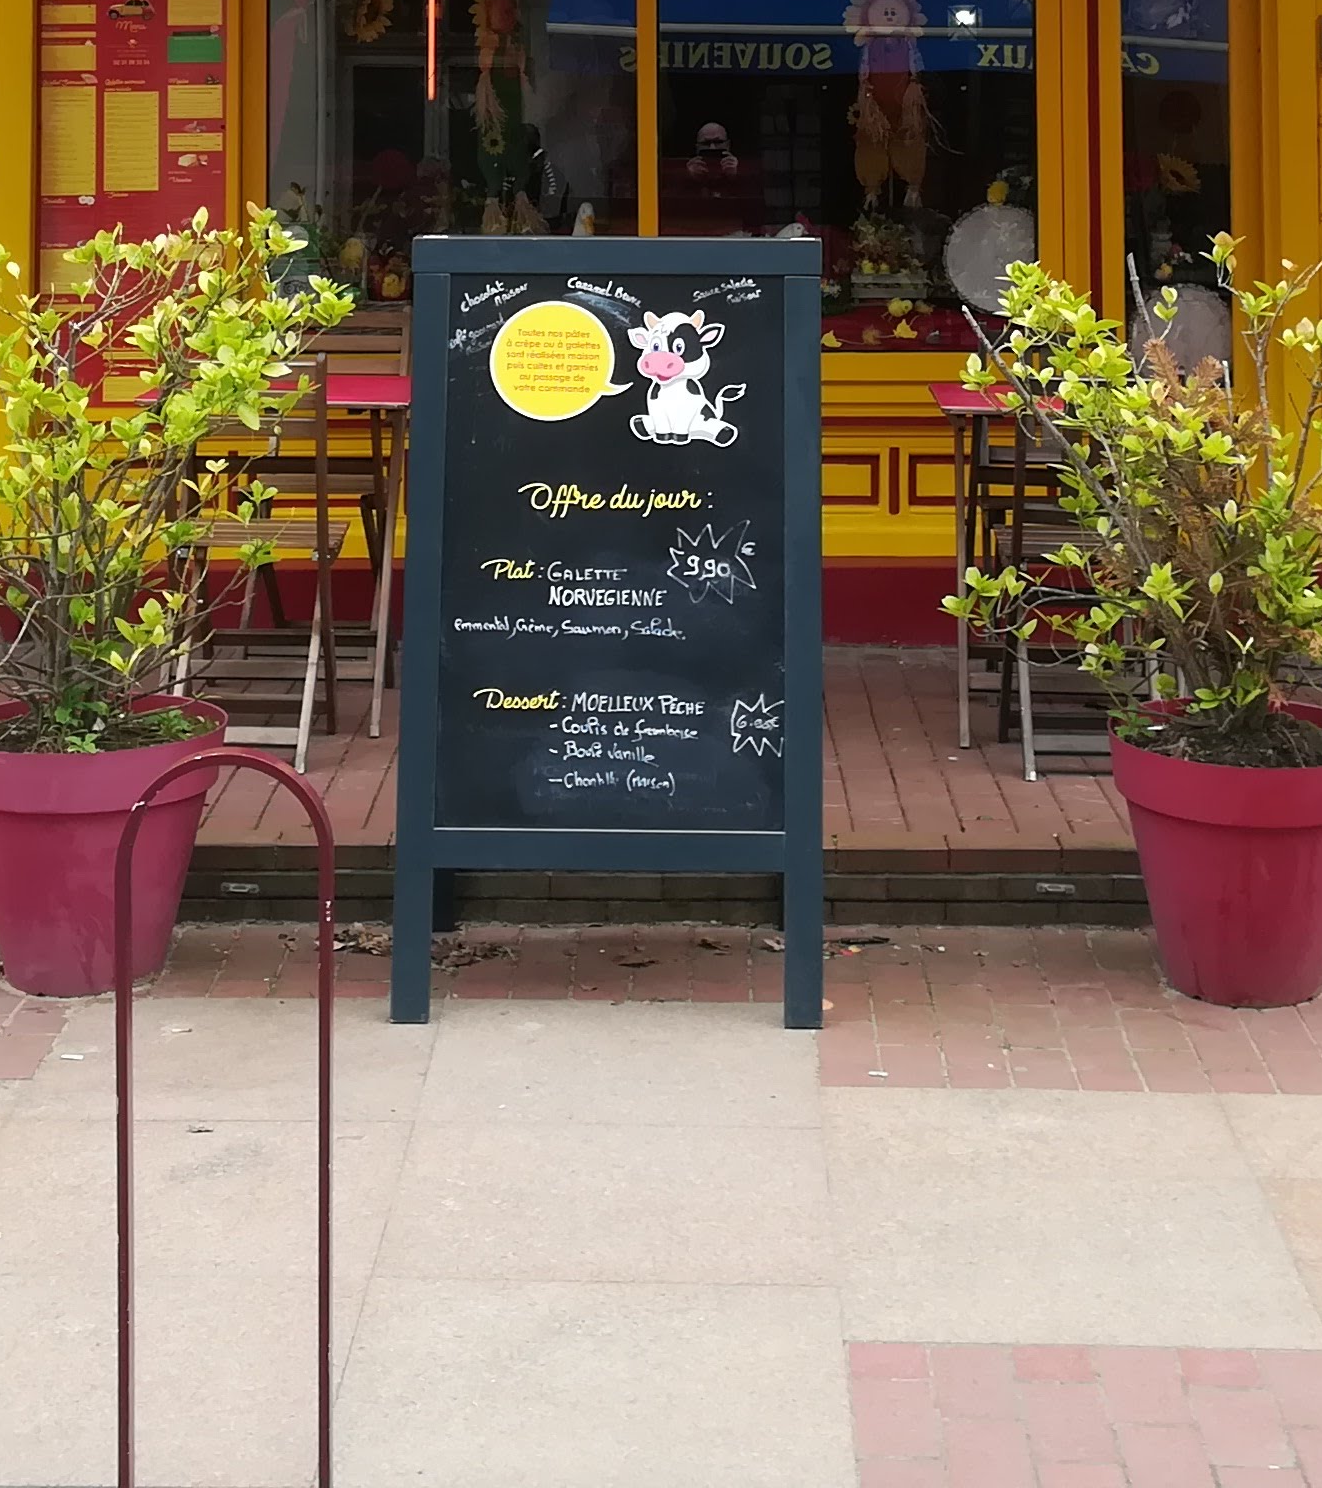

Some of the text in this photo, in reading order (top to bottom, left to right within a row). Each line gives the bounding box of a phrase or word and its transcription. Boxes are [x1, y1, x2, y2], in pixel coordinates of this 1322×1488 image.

[517, 329, 546, 338] Toutes
[547, 330, 564, 338] nos
[543, 341, 556, 349] ou
[565, 340, 602, 351] galettes
[506, 349, 601, 361] sont réalisées maison
[506, 362, 600, 373] puis cuites et garnies
[519, 373, 586, 384] au passage de
[513, 384, 591, 394] votre commande
[518, 481, 606, 518] Offre
[610, 484, 645, 510] du
[548, 586, 669, 608] NORVEGIENNE
[473, 688, 562, 710] Dessert
[570, 691, 655, 714] MOELLEUX
[613, 719, 630, 737] de
